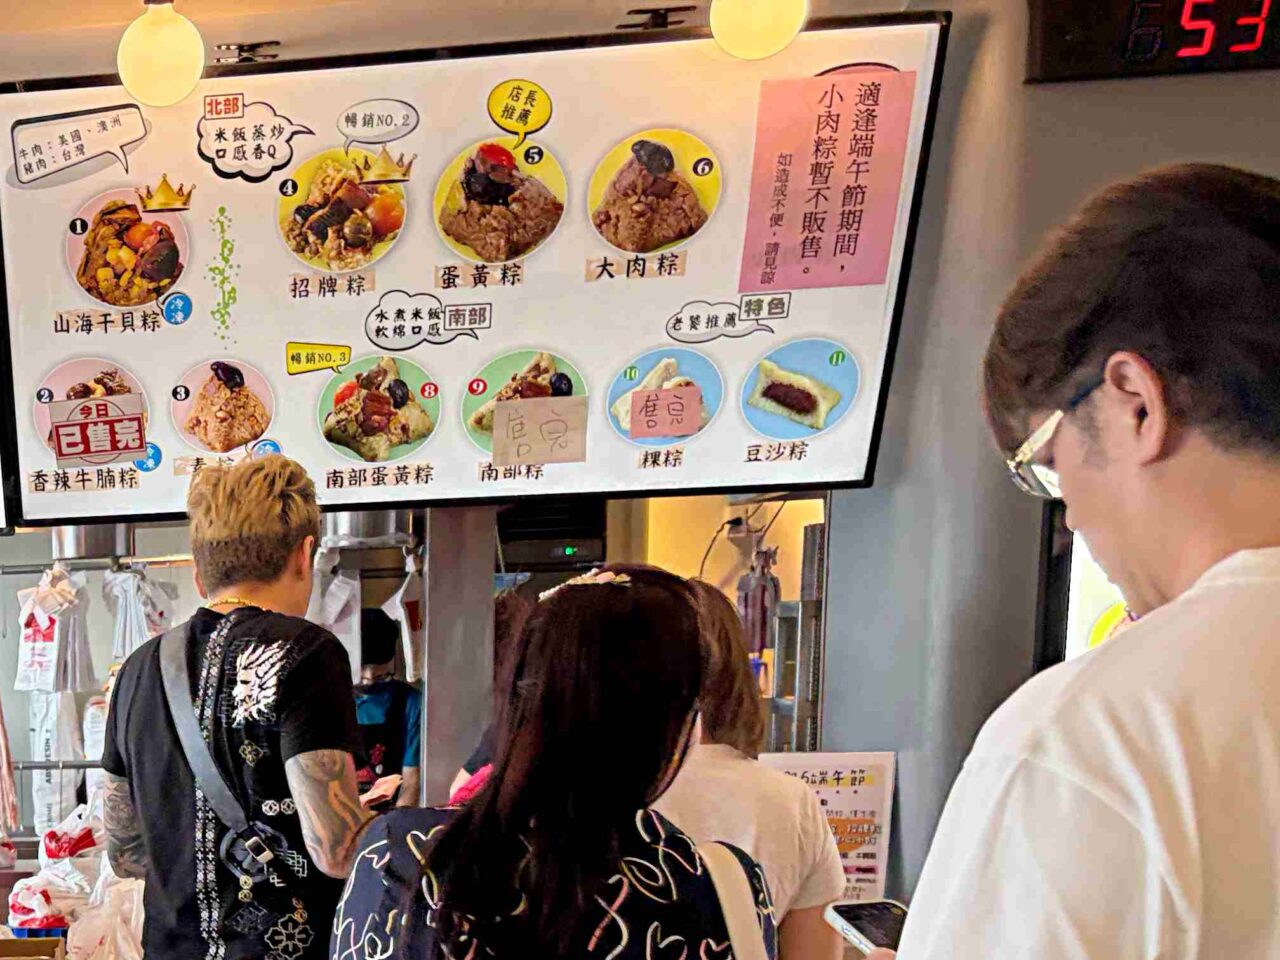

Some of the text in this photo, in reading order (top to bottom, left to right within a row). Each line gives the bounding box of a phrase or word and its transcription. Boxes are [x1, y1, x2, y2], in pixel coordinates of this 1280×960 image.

[207, 97, 239, 116] 北部
[509, 84, 537, 108] 店長
[214, 123, 285, 143] 米飯蒸炒
[800, 83, 844, 275] 小肉粽暫不販售。
[832, 81, 882, 273] 適逢端午節期間，
[440, 263, 521, 289] 蛋黃粽
[596, 252, 679, 280] 大肉粽
[290, 274, 366, 299] 招牌粽
[375, 306, 441, 323] 水煮米飯
[448, 307, 487, 326] 南部
[742, 294, 787, 318] 特色
[53, 311, 161, 334] 山海干貝粽
[79, 403, 108, 418] 今日
[58, 417, 143, 454] 已售完
[641, 449, 684, 470] 粿粽
[744, 441, 809, 464] 豆沙粽
[31, 469, 139, 493] 香辣牛腩粽
[326, 465, 435, 489] 南部蛋黃粽
